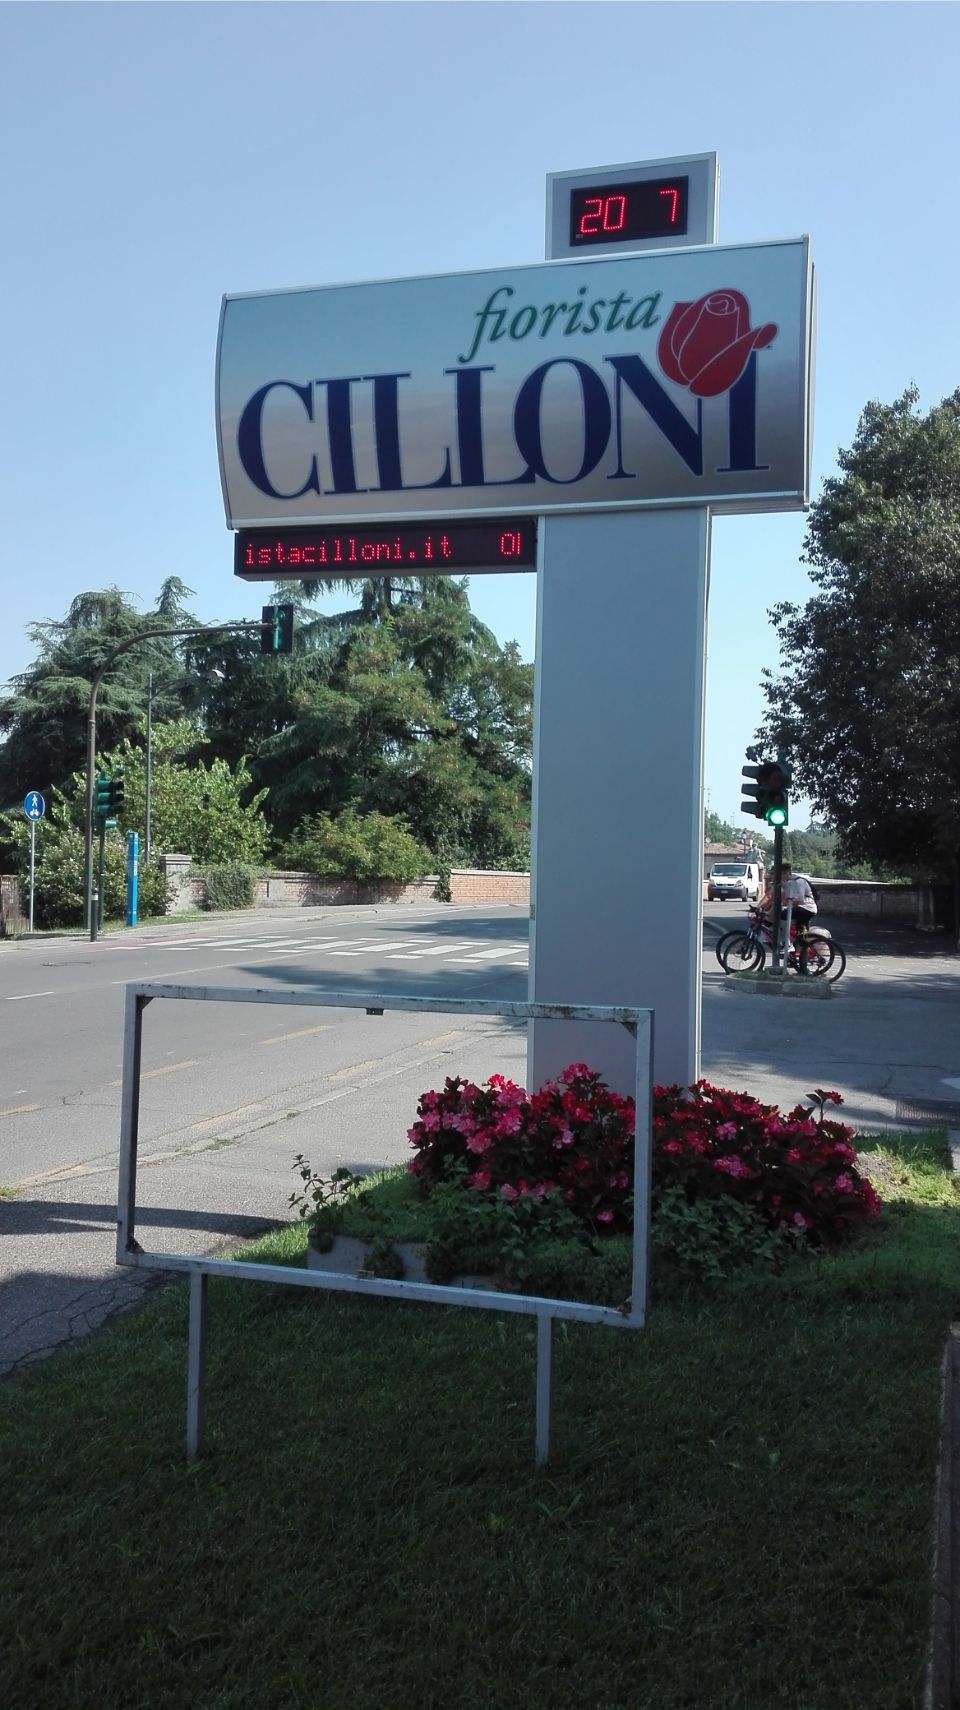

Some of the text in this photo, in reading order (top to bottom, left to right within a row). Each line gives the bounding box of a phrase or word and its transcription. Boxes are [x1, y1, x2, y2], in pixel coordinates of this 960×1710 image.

[579, 196, 627, 233] 20
[457, 285, 664, 363] fiorista
[237, 351, 770, 500] CILLONI
[244, 536, 453, 565] istacilloni.it
